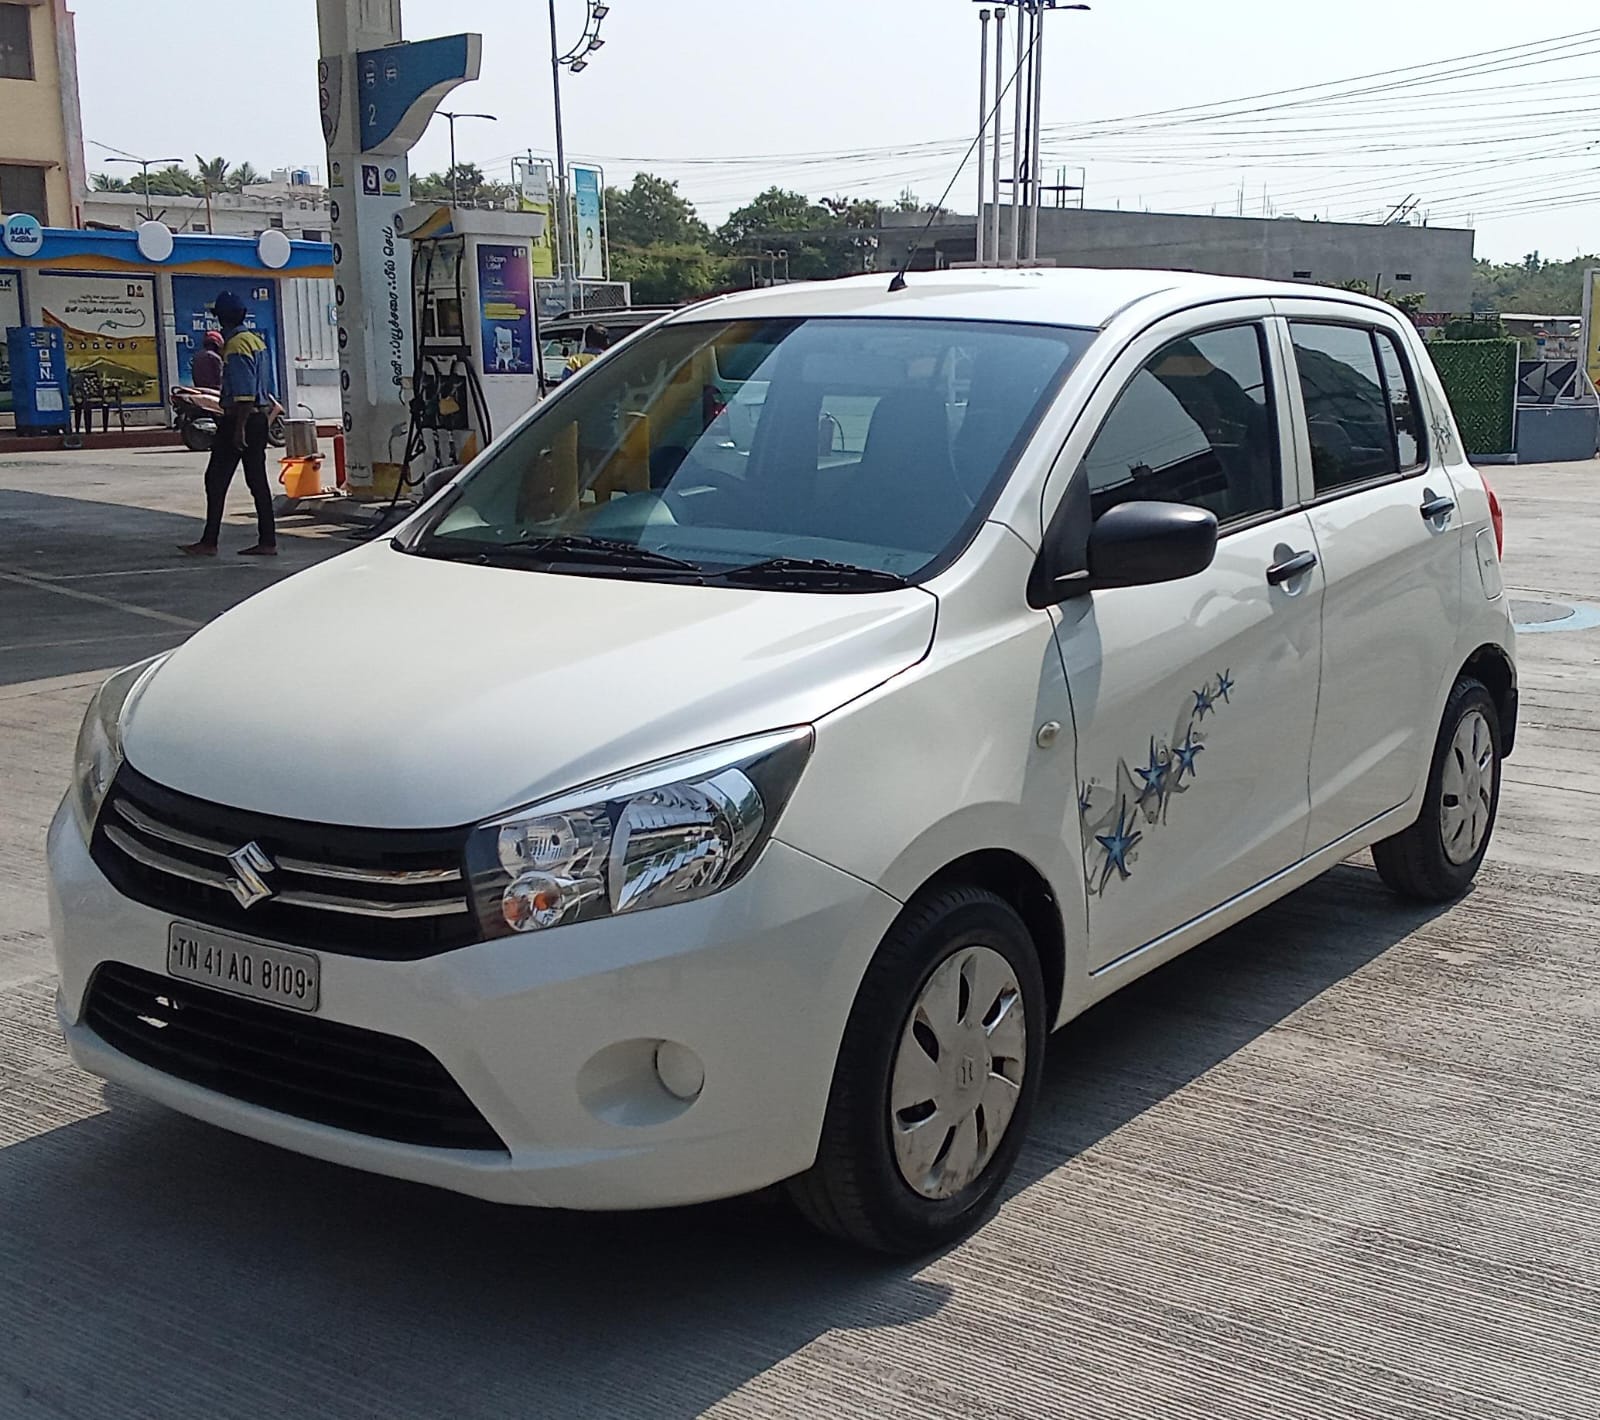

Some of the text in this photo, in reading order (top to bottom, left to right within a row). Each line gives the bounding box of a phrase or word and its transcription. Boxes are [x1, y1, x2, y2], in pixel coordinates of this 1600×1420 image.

[368, 104, 376, 126] 2
[10, 226, 32, 236] MAK
[178, 937, 306, 999] TN 41 AQ 8109
